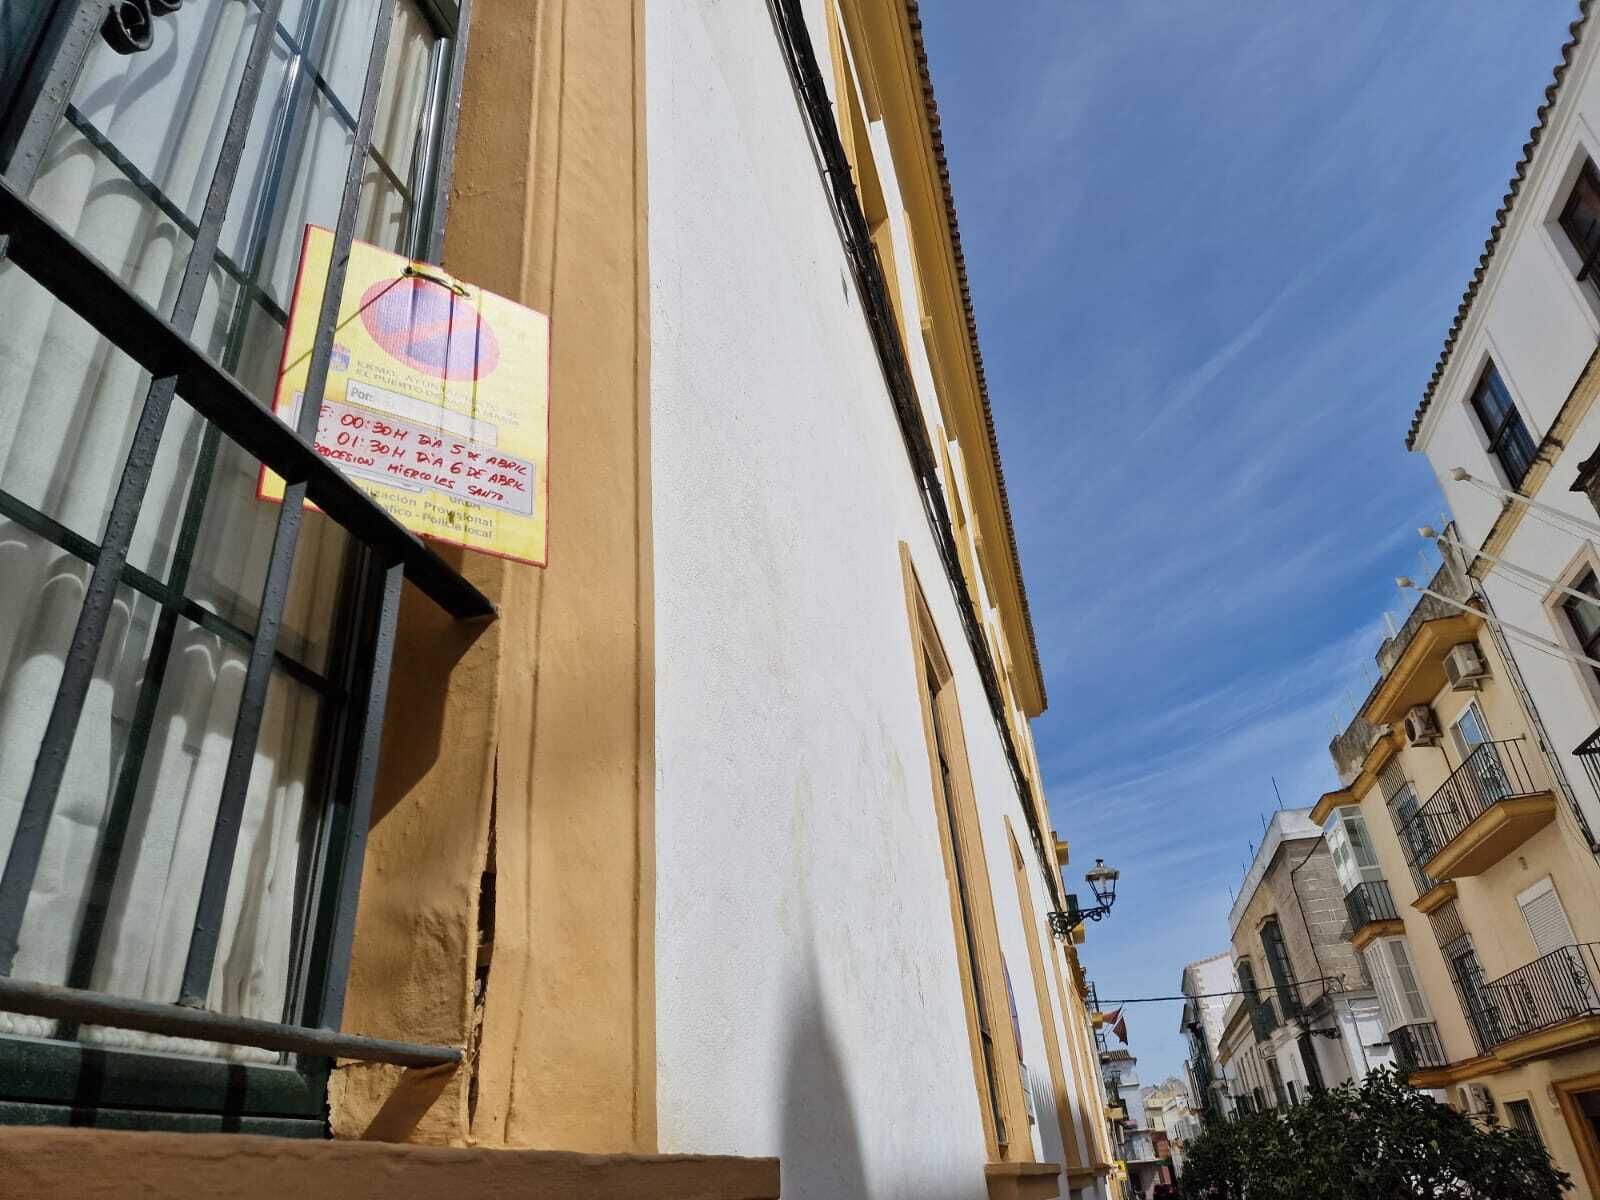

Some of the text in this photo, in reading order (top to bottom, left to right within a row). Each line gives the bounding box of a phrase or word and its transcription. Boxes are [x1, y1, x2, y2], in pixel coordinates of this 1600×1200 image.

[449, 443, 465, 455] 5
[467, 451, 481, 462] DE
[485, 456, 528, 476] ABRIL
[450, 461, 464, 474] 6
[466, 466, 487, 480] DE
[488, 473, 526, 492] ABRIL
